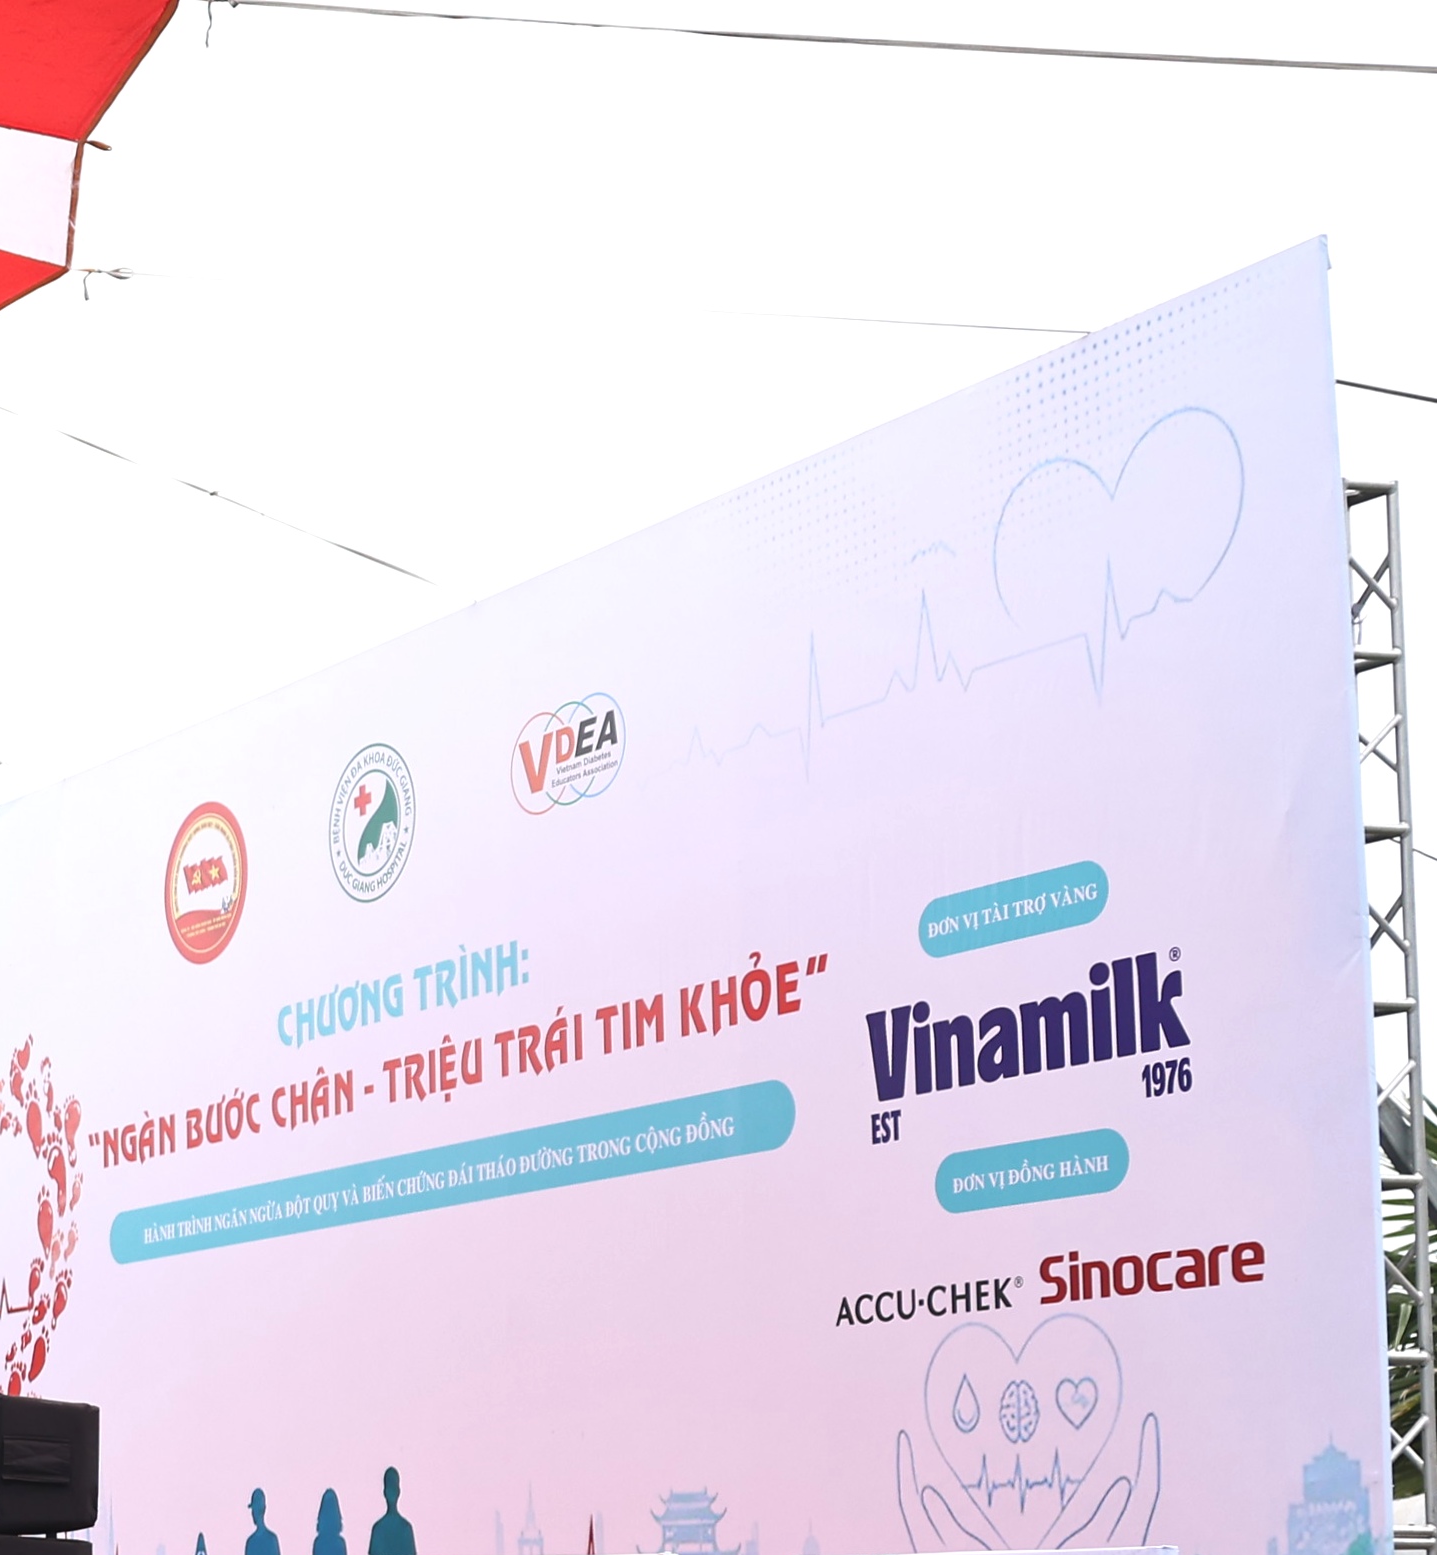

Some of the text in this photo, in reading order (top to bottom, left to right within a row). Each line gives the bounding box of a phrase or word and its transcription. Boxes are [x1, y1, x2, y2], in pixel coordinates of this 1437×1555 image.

[363, 751, 385, 767] KHOA
[519, 709, 618, 794] VDEA
[551, 760, 618, 788] Educators Association
[556, 751, 611, 775] Vietnam Diabetes
[377, 841, 407, 890] HOSPITAL
[927, 880, 1099, 940] ĐƠN VỊ TÀI TRỢ VÀNG
[276, 939, 530, 1049] CHƯƠNG TRÌNH:
[186, 1085, 260, 1149] BƯỚC
[272, 1066, 354, 1131] CHÂN
[382, 1035, 483, 1104] TRIỆU
[494, 1005, 584, 1077] TRÁI
[595, 995, 664, 1055] TIM
[870, 1057, 1194, 1146] EST 1976
[144, 1222, 175, 1244] HÀNH
[177, 1216, 212, 1238] TRÌNH
[214, 1209, 248, 1233] NGĂN
[249, 1200, 282, 1225] NGỪA
[285, 1194, 311, 1219] ĐỘT
[342, 1186, 360, 1206] VÀ
[362, 1175, 395, 1203] BIẾN
[397, 1170, 445, 1197] CHỨNG
[449, 1161, 473, 1187] ĐÁI
[477, 1154, 517, 1181] THÁO
[519, 1146, 573, 1174] ĐƯỜNG
[576, 1136, 631, 1163] TRONG
[634, 1126, 682, 1155] CỘNG
[685, 1112, 735, 1143] ĐỒNG
[952, 1151, 1110, 1195] ĐƠN VỊ ĐỒNG HÀNH
[1039, 1239, 1266, 1306] Sinocare
